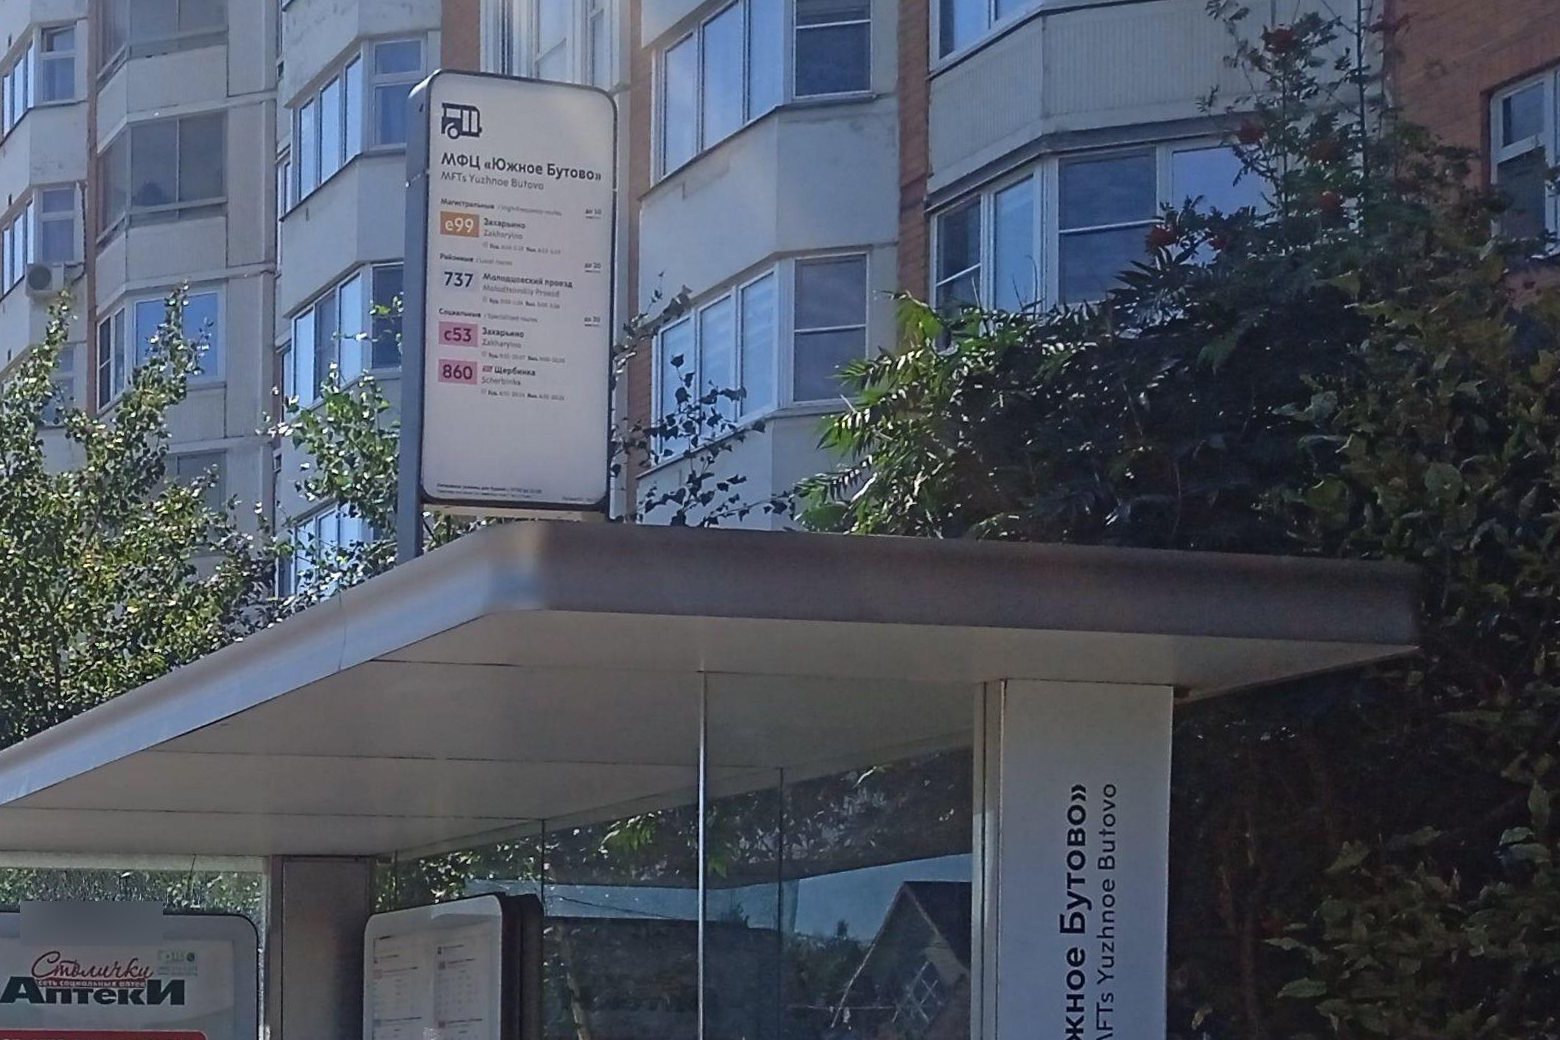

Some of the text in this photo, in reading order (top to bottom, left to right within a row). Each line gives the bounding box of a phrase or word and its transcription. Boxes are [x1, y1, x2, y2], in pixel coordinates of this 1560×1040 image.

[440, 171, 544, 190] MFTs Yuzhnoe Butovo
[441, 152, 601, 181] МФЦ «Южное Бутово»
[443, 271, 474, 287] 737
[442, 364, 473, 380] 860
[1098, 783, 1117, 870] Butovo
[1059, 784, 1092, 934] Бутово»
[1096, 878, 1116, 985] Yuzhnoe
[31, 950, 153, 979] Столички
